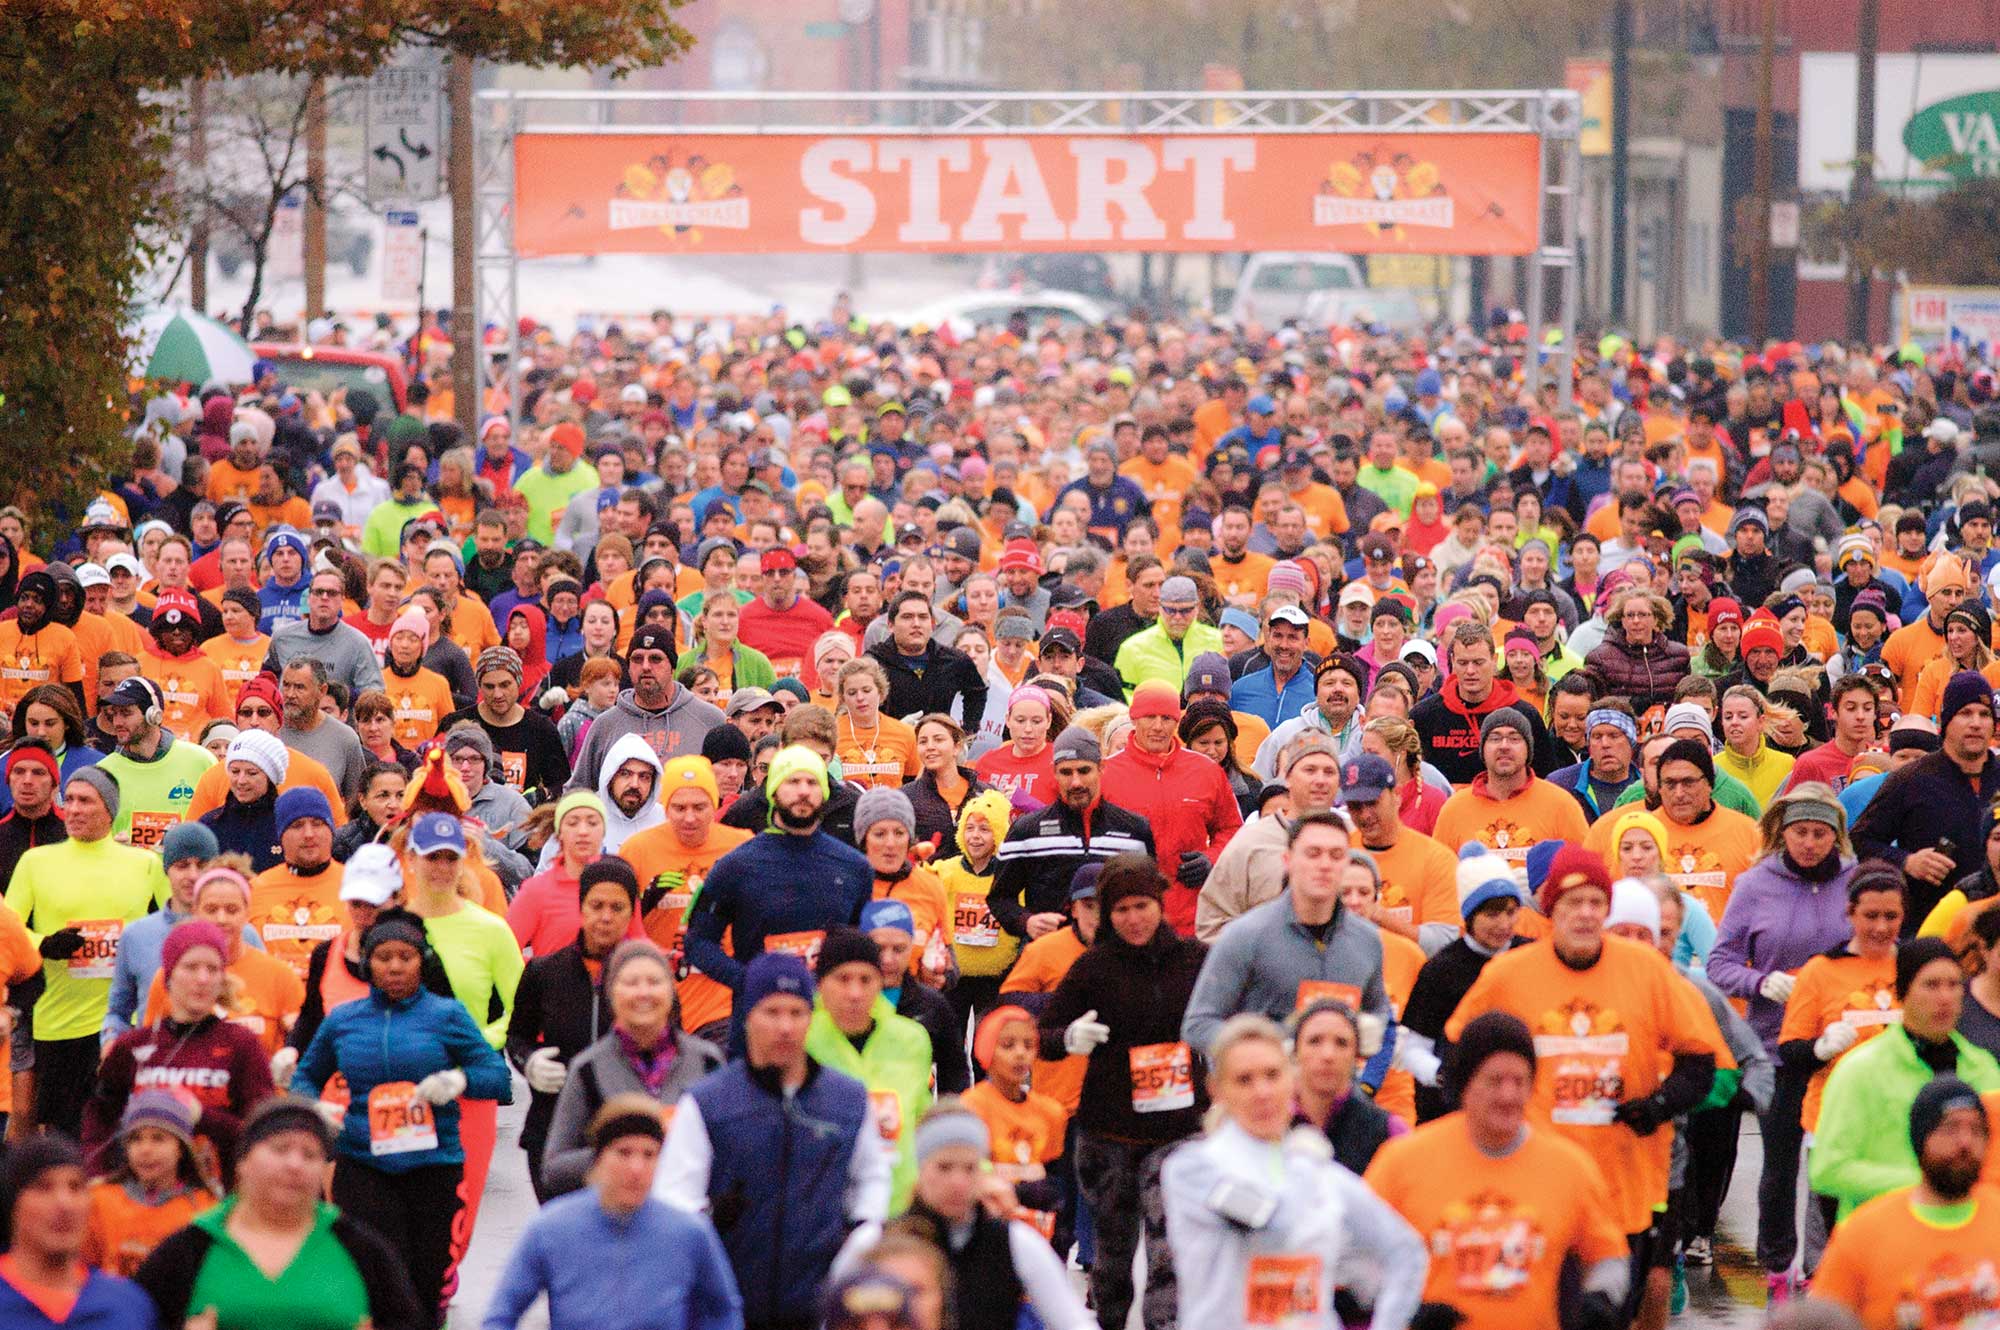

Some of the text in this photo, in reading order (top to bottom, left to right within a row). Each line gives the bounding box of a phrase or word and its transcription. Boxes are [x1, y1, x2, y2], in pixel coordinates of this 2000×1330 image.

[800, 138, 1256, 245] START
[989, 773, 1039, 794] BEAT
[377, 1104, 424, 1130] 730
